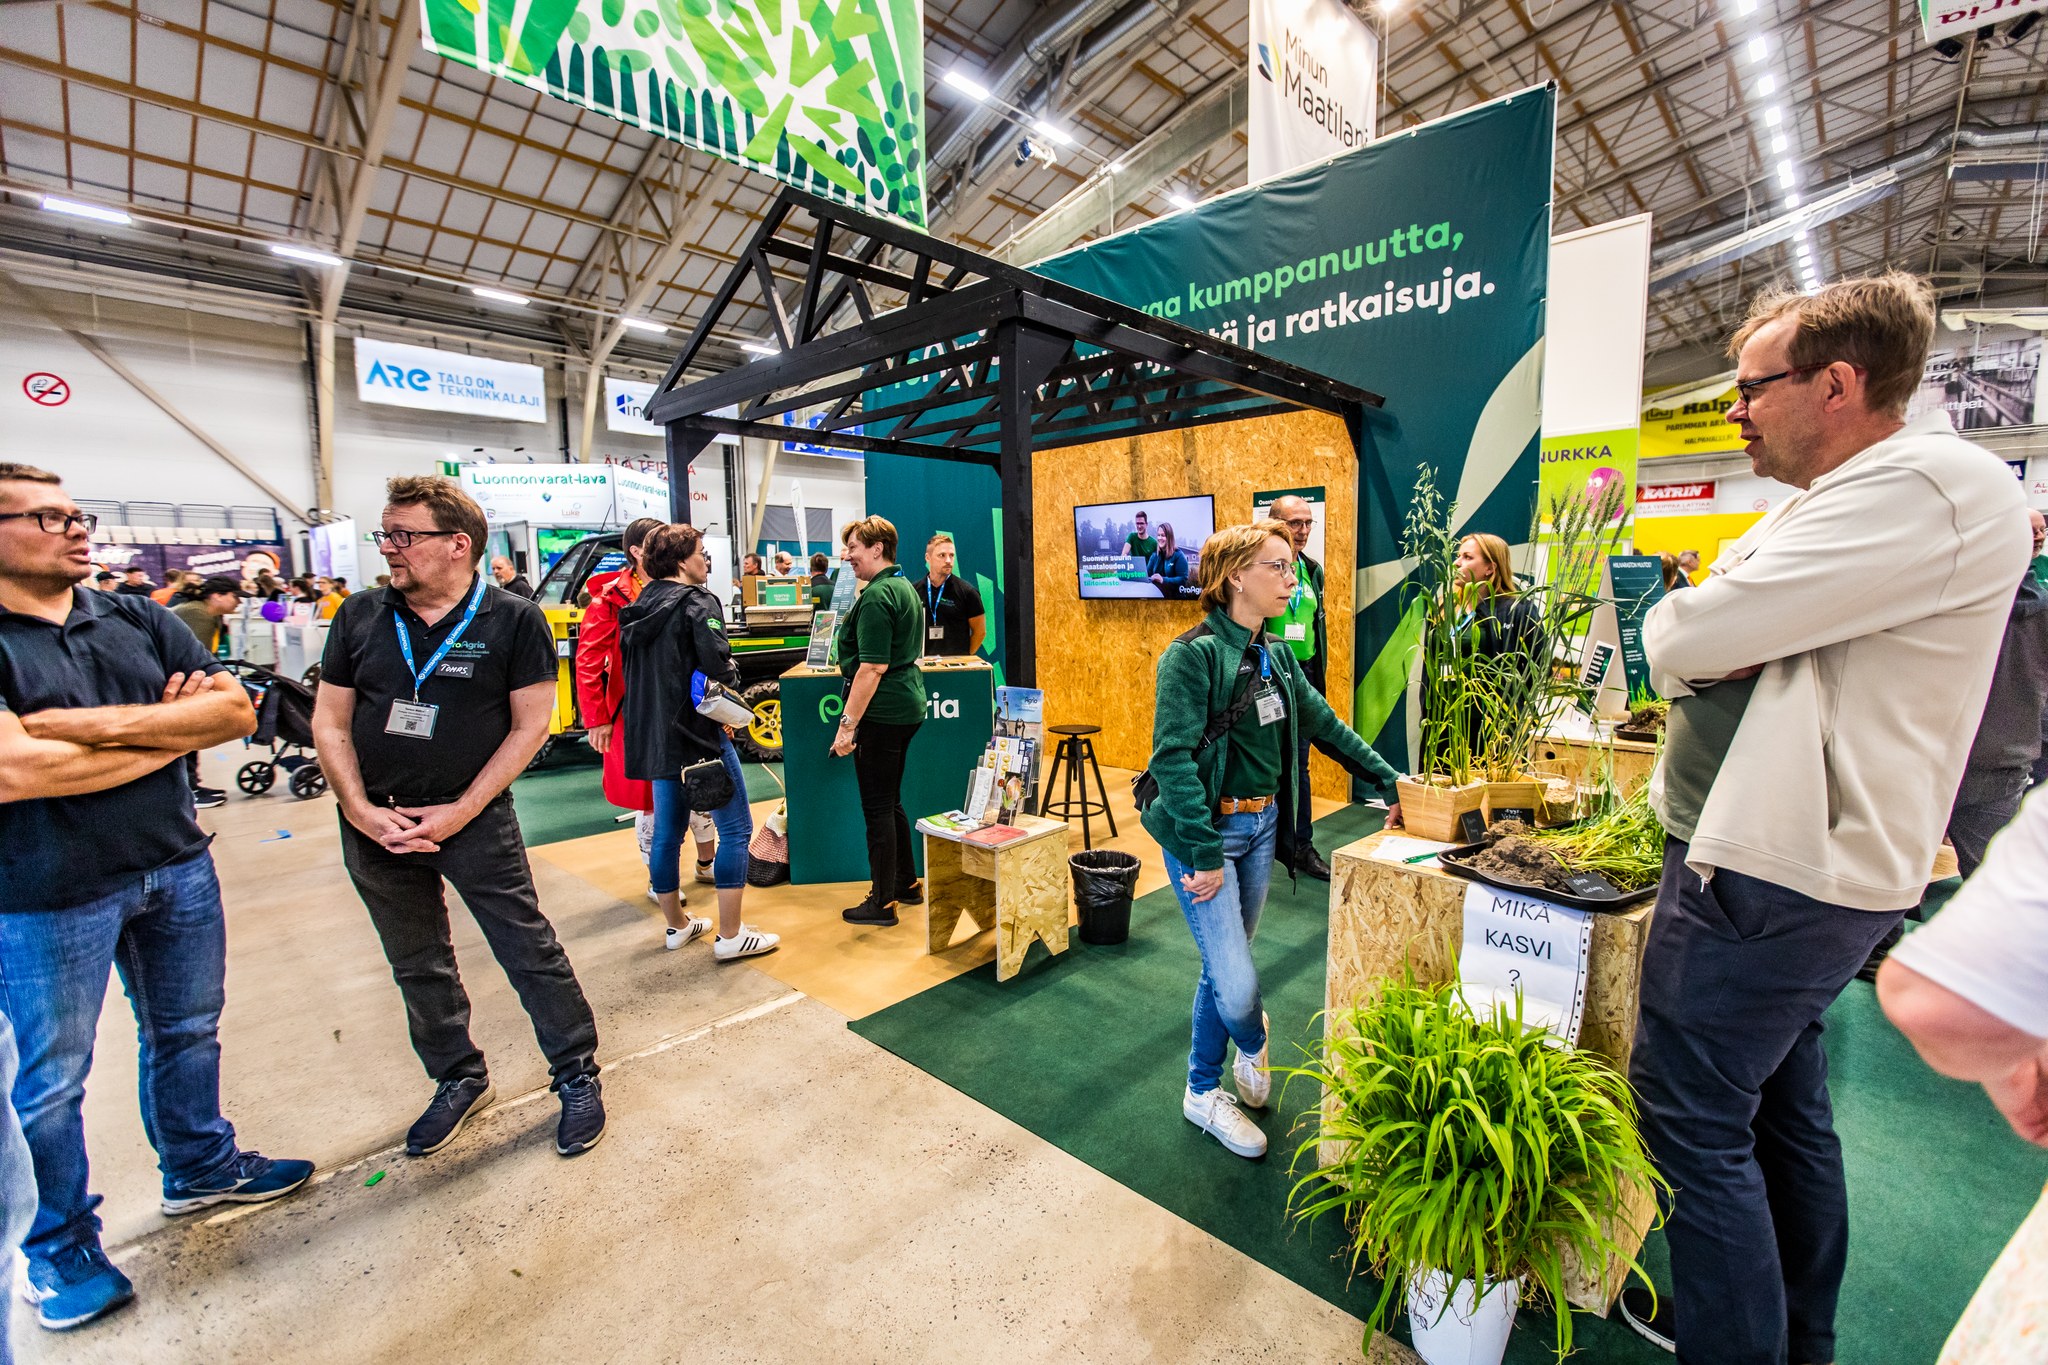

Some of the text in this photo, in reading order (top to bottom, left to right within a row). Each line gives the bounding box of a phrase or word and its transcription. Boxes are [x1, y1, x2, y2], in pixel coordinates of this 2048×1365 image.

[1285, 27, 1328, 89] Minun
[1189, 221, 1464, 313] kumppanuutta,
[1247, 314, 1276, 350] ja
[1285, 266, 1496, 338] ratkaisuja.
[438, 371, 473, 388] TALO
[476, 377, 495, 390] ON
[438, 383, 540, 407] TEKNIIKKALAJI
[1682, 399, 1733, 415] Halp
[472, 473, 607, 485] Luonnonvarat-lava
[1643, 485, 1708, 500] KATRIN
[1082, 562, 1134, 571] maatalouden ja
[452, 640, 486, 650] roAgria
[1491, 896, 1551, 924] MIKÄ
[1485, 928, 1552, 960] KASVI
[1508, 969, 1521, 987] ?
